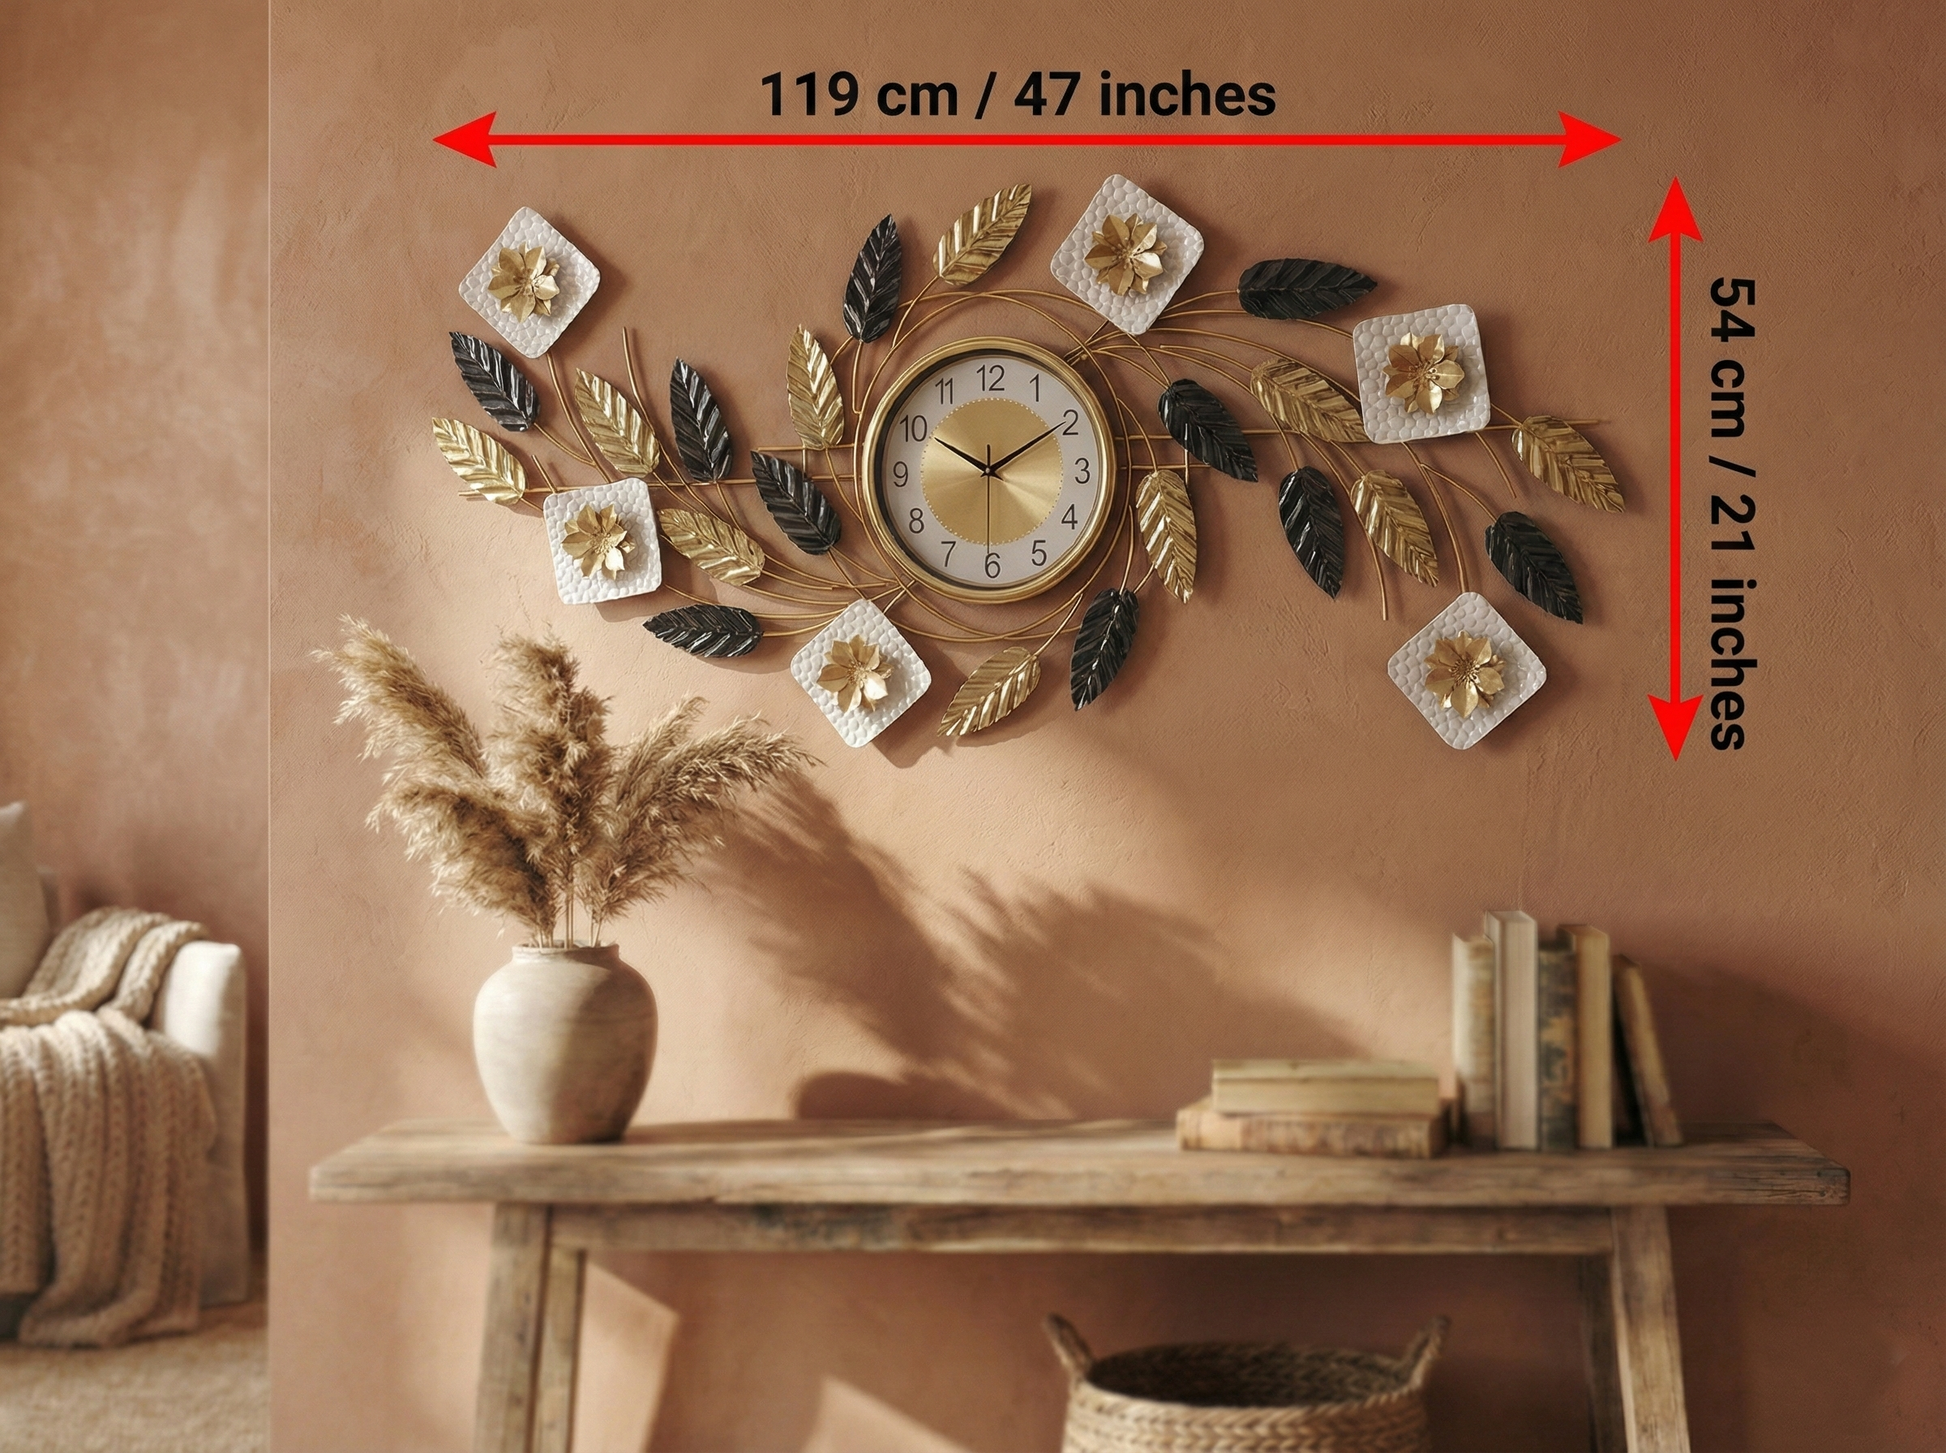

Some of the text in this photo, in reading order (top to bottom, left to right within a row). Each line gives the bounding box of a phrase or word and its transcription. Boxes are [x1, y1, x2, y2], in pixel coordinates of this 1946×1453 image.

[935, 377, 954, 405] 11
[976, 364, 1005, 392] 12
[1029, 373, 1040, 403] 1
[899, 414, 928, 443] 10
[1062, 409, 1079, 436] 2
[892, 460, 909, 488] 9
[1074, 457, 1091, 485] 3
[908, 507, 925, 535] 8
[1061, 503, 1078, 530] 4
[940, 540, 957, 568] 7
[984, 552, 1001, 579] 6
[1031, 539, 1048, 567] 5
